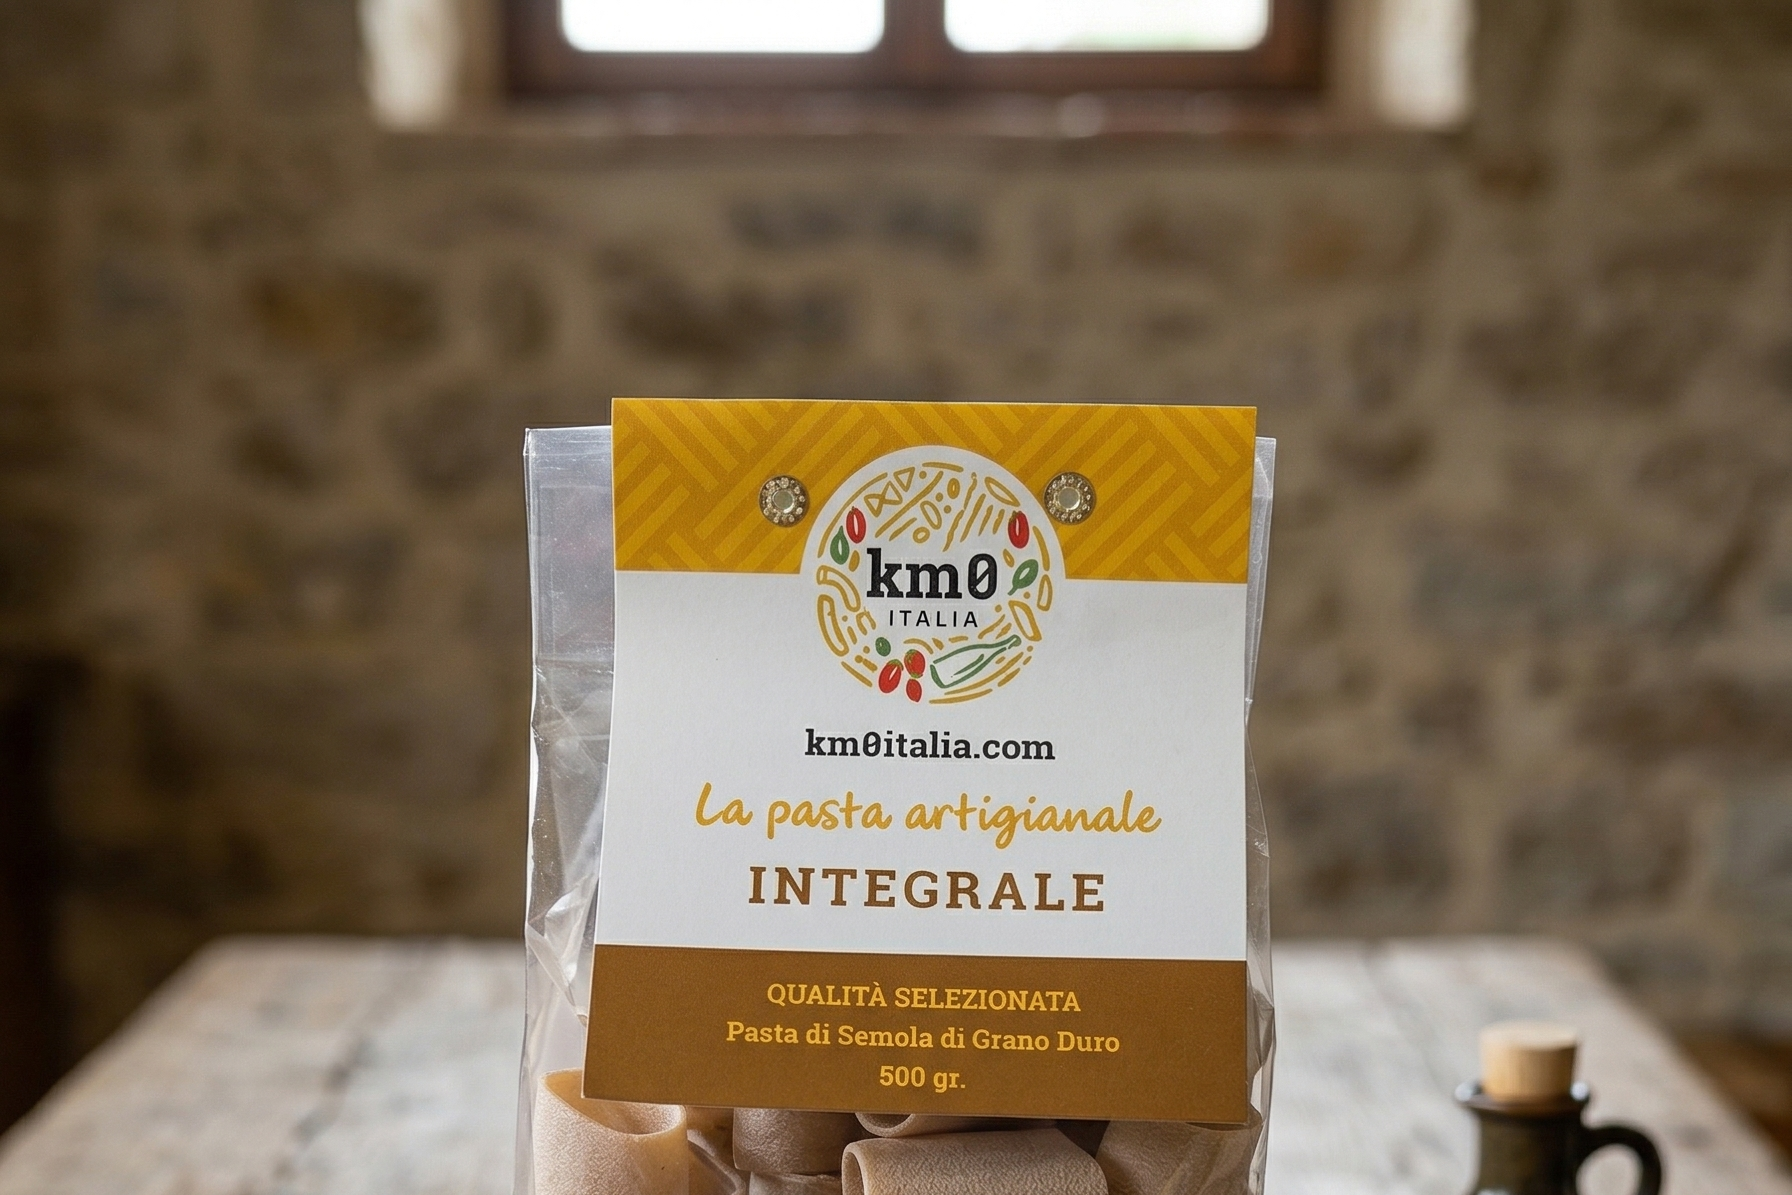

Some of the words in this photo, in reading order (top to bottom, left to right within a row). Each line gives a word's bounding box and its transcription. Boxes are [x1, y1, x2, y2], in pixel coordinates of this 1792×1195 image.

[867, 548, 997, 600] km0
[889, 609, 979, 628] ITALIA
[805, 729, 1055, 759] km0italia.com
[695, 782, 753, 826] La
[767, 791, 892, 839] pasta
[905, 790, 1161, 850] artigianale
[749, 866, 1104, 912] INTEGRALE
[768, 982, 887, 1006] QUALITÀ
[895, 988, 1081, 1011] SELEZIONATA
[726, 1022, 798, 1043] Pasta
[806, 1023, 830, 1044] di
[838, 1025, 933, 1047] Semola
[941, 1027, 965, 1048] di
[973, 1029, 1049, 1050] Grano
[1057, 1031, 1119, 1052] Duro
[880, 1066, 925, 1087] 500
[934, 1072, 965, 1093] gr.
